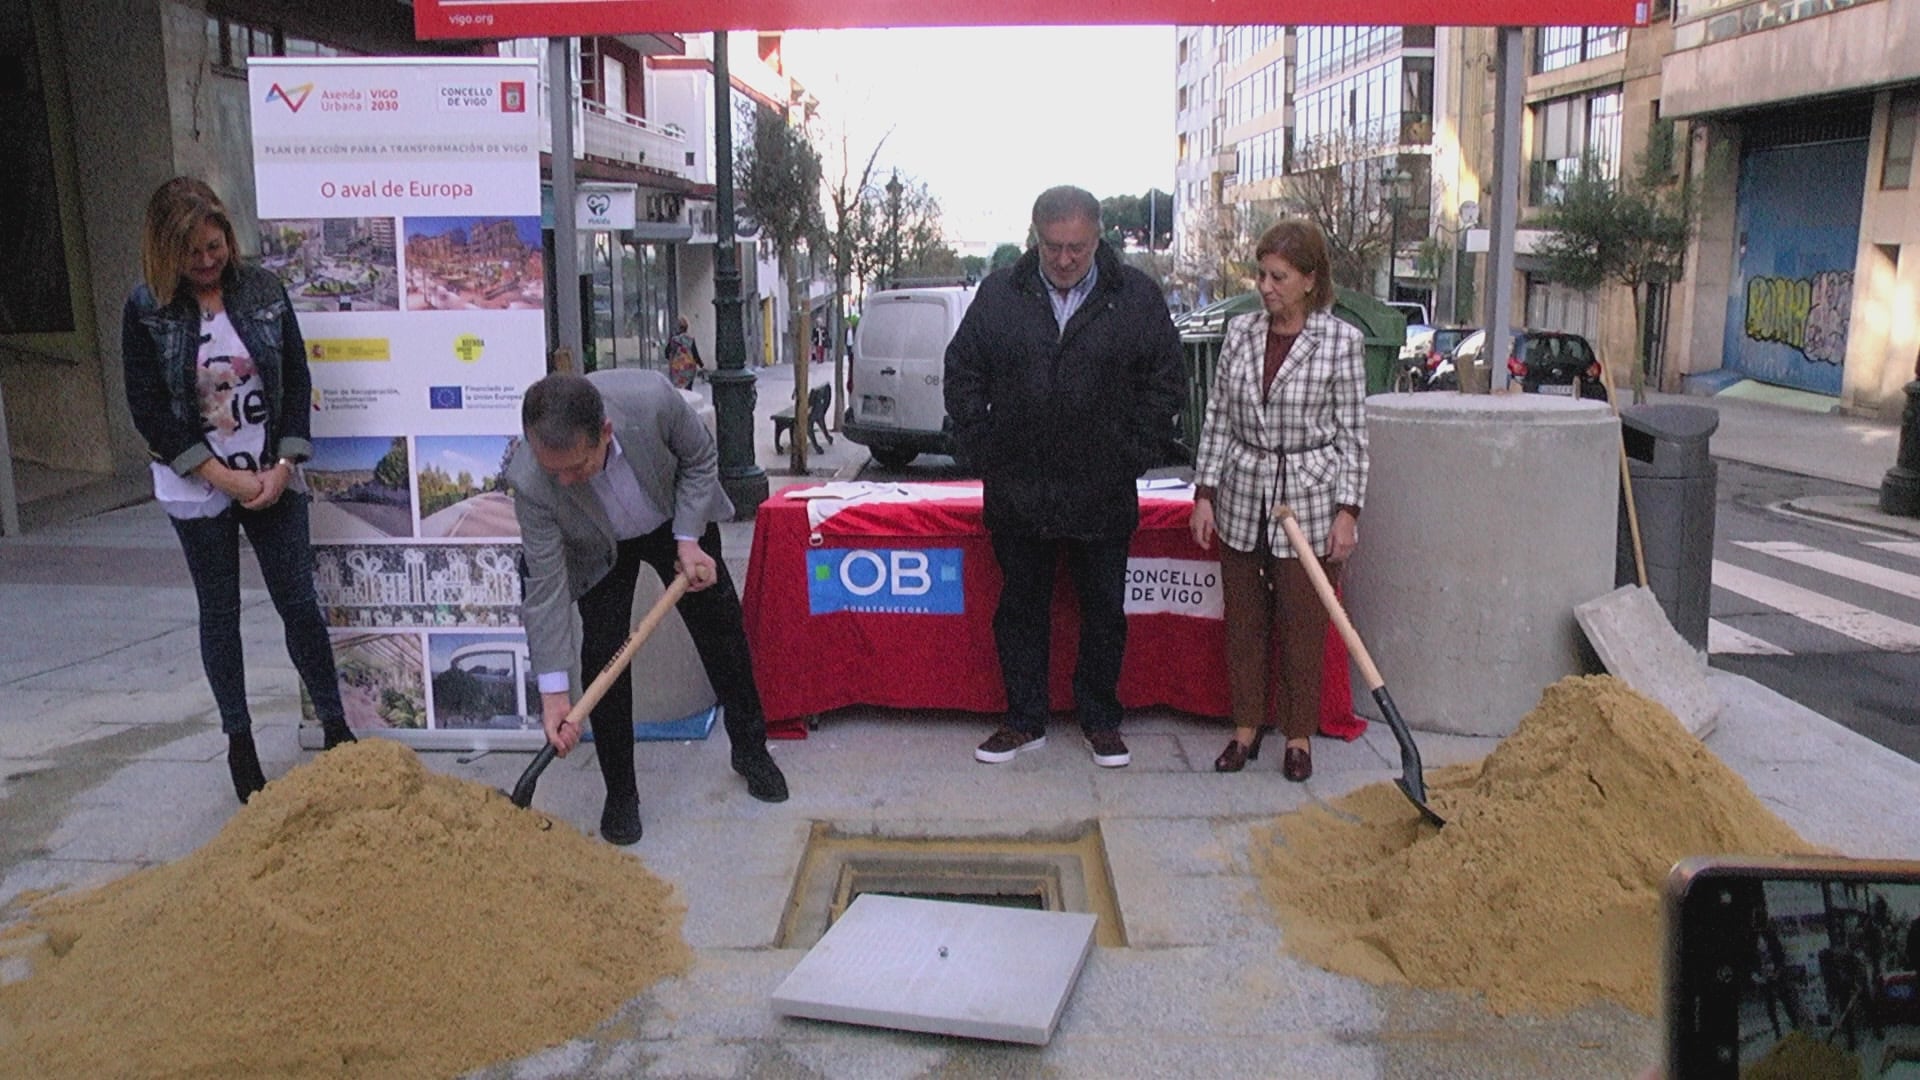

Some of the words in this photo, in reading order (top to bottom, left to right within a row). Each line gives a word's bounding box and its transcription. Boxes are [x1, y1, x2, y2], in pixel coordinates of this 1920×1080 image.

[448, 13, 494, 26] vigo.org
[321, 88, 362, 100] Axenda
[370, 89, 399, 99] VIGO
[441, 87, 494, 97] CONCELLO
[321, 101, 362, 112] Urbana
[371, 101, 399, 111] 2030
[447, 97, 462, 107] DE
[463, 96, 488, 107] VIGO
[265, 144, 292, 155] PLAN
[294, 144, 308, 155] DE
[309, 142, 348, 154] ACCIÓN
[351, 144, 378, 154] PARA
[380, 144, 388, 154] A
[390, 142, 484, 154] TRANSFORMACIÓN
[486, 143, 500, 153] DE
[503, 143, 528, 153] VIGO
[321, 182, 337, 198] O
[341, 181, 376, 198] aval
[381, 180, 404, 197] de
[410, 181, 473, 200] Europa
[839, 550, 932, 596] OB
[1124, 568, 1216, 588] CONCELLO
[1131, 587, 1155, 602] DE
[1160, 588, 1204, 605] VIGO
